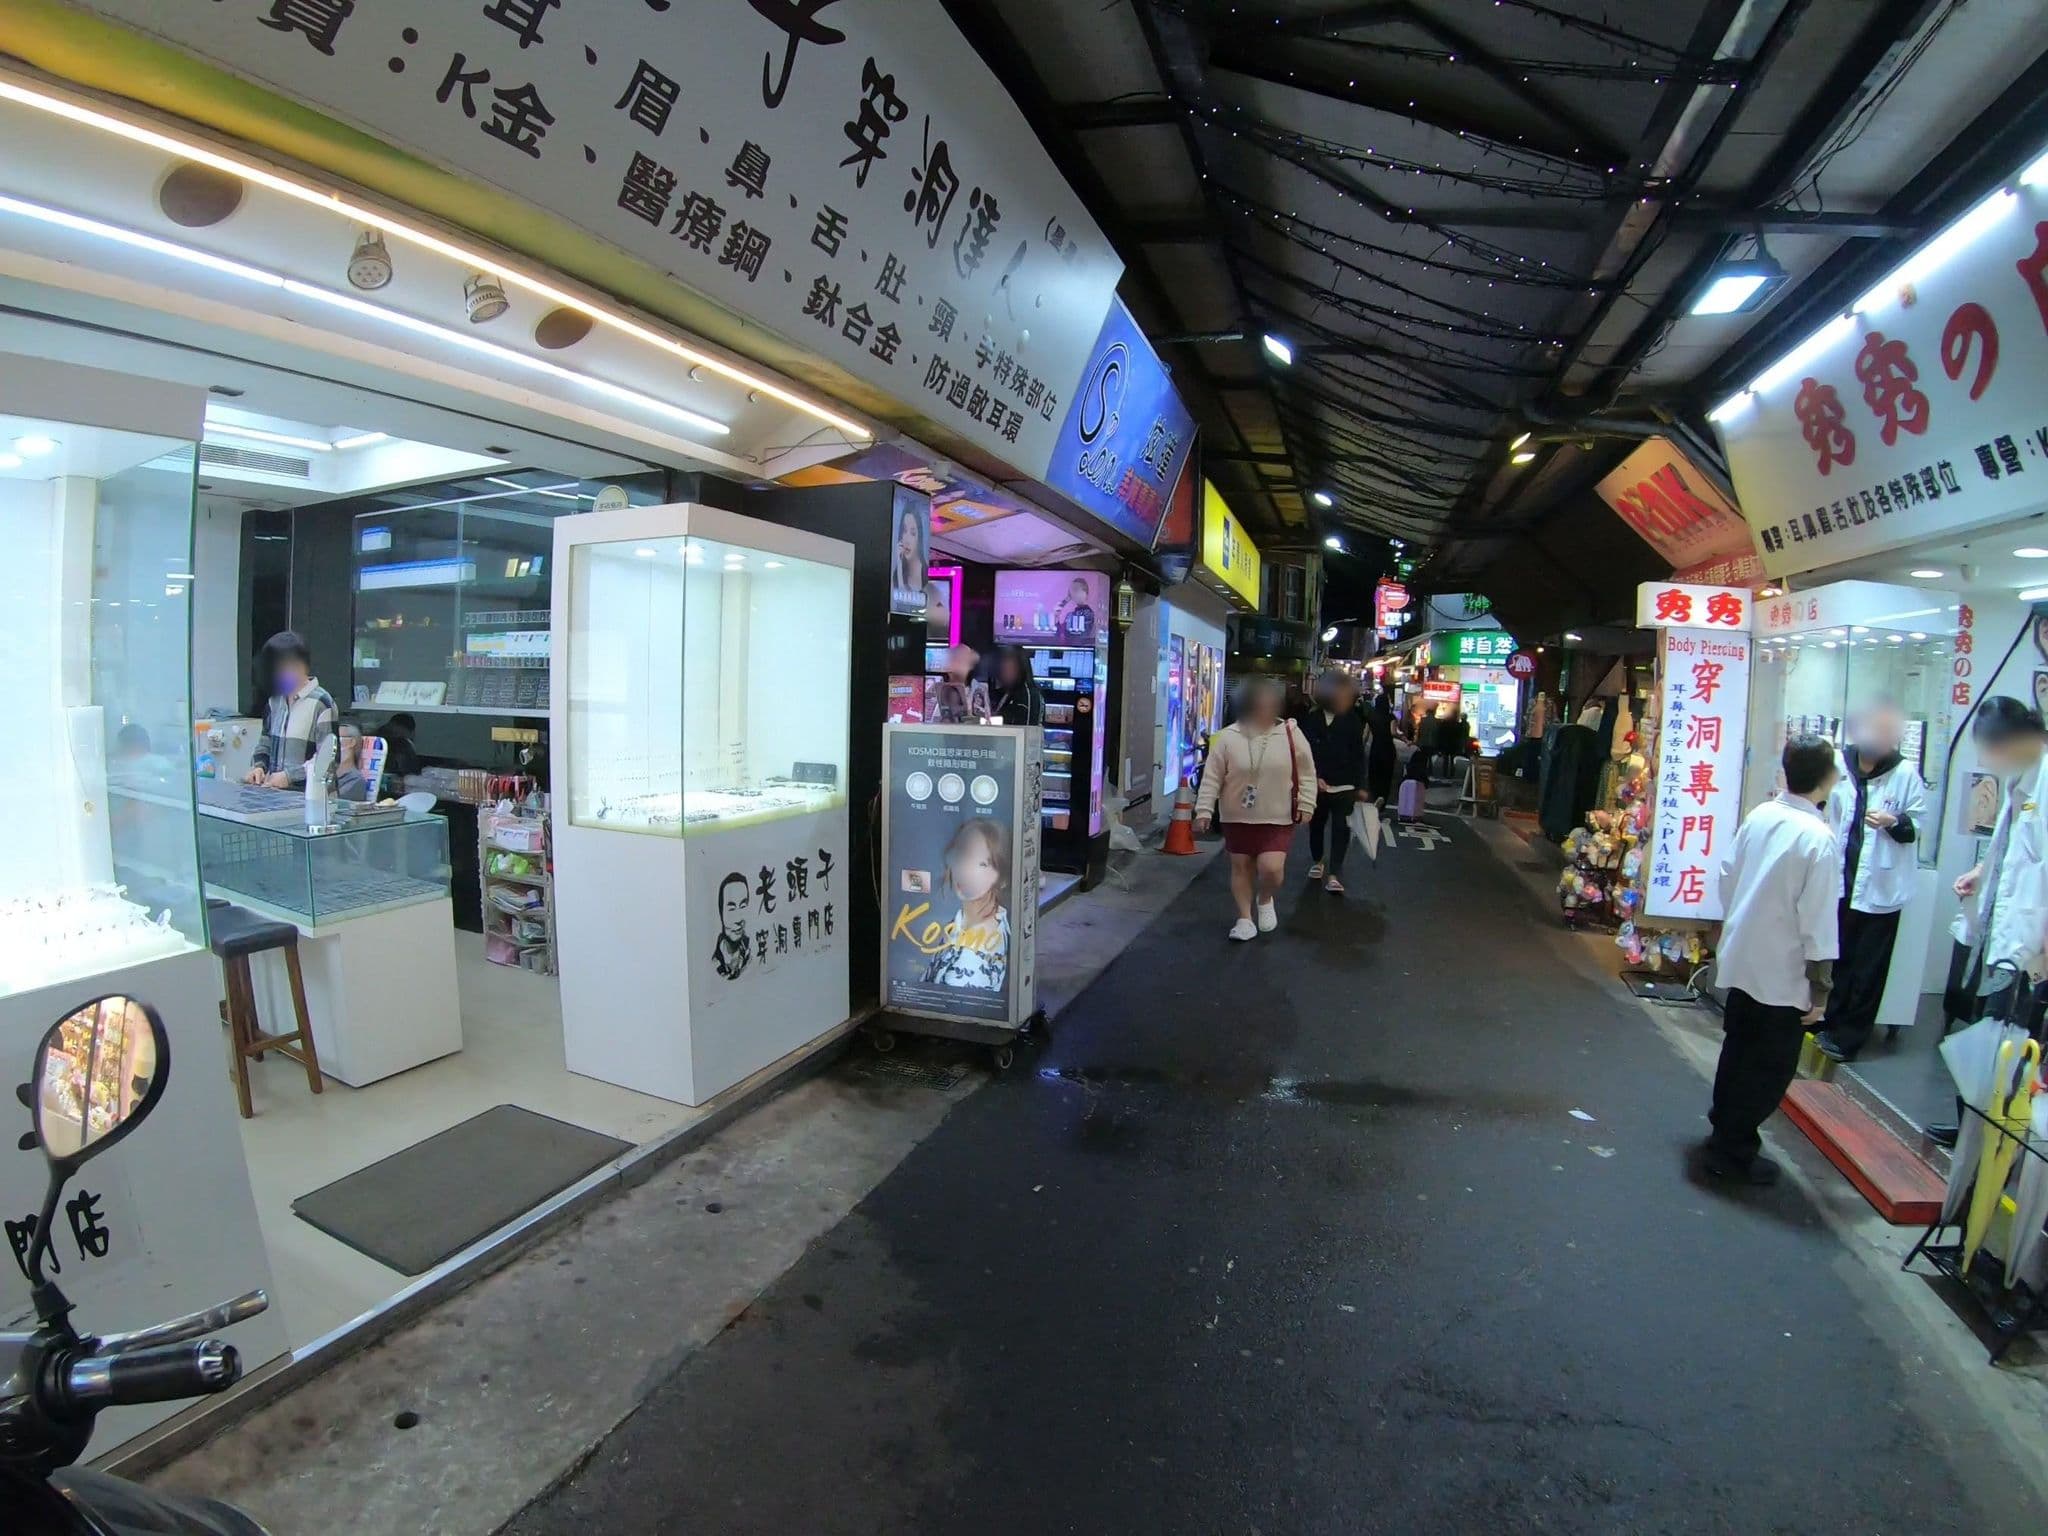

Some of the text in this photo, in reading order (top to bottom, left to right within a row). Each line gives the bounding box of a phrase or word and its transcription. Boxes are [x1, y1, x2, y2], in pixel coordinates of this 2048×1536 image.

[1458, 636, 1515, 655] 鮮自然
[1667, 636, 1745, 661] Body Piercing
[1668, 658, 1724, 905] 穿洞專門店
[755, 848, 836, 916] 老頭子
[755, 901, 835, 965] 穿洞專門店
